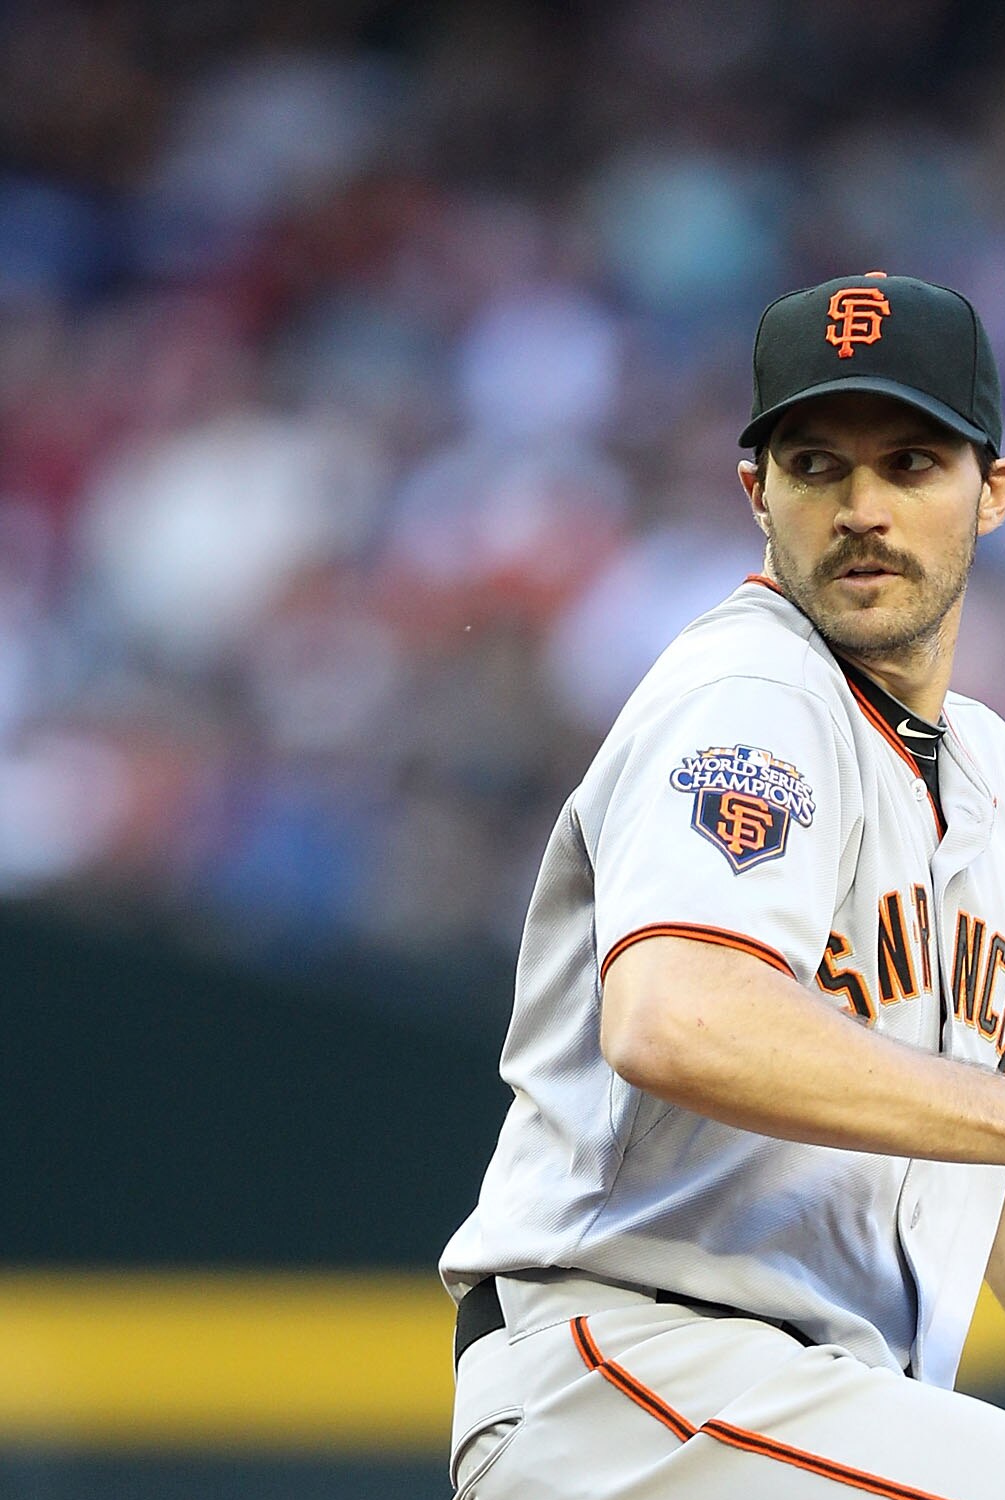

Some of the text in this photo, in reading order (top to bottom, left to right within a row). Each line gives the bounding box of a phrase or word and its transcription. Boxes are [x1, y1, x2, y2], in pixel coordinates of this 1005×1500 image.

[825, 288, 891, 358] SF
[671, 769, 816, 825] CHAMPIONS
[684, 757, 757, 777] WORLD
[759, 767, 812, 800] SERIES
